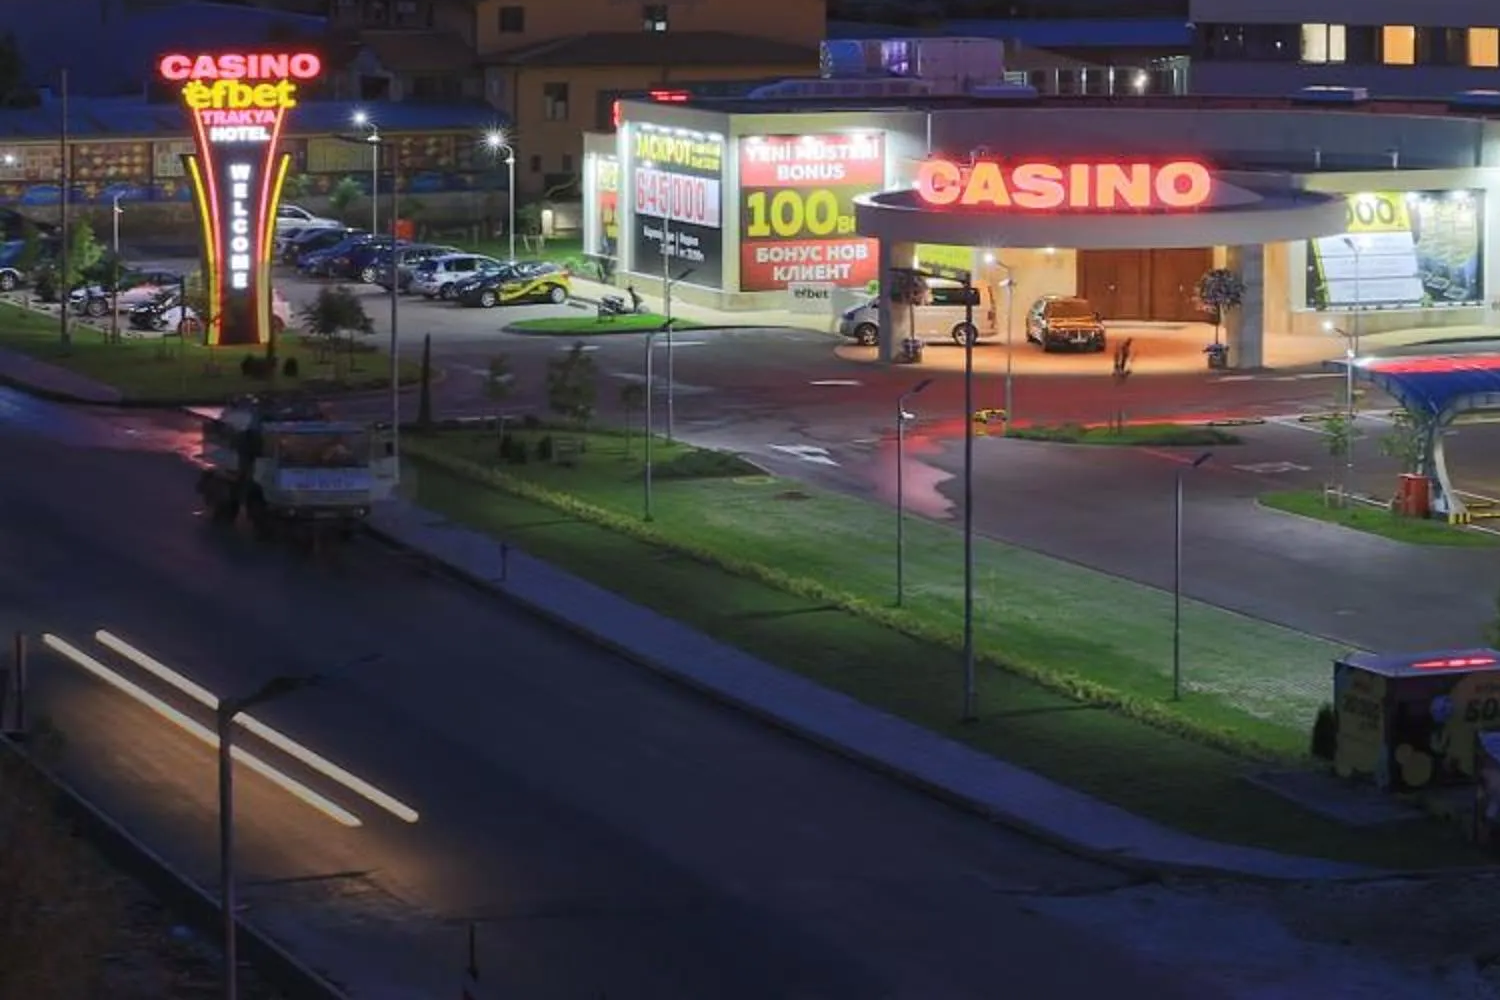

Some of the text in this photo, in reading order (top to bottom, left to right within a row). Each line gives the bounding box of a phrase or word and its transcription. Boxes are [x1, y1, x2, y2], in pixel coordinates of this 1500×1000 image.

[160, 54, 320, 80] CASINO
[184, 80, 297, 108] efbet
[202, 110, 276, 124] TRAKYA
[210, 126, 270, 141] HOTEL
[777, 164, 846, 181] BONUS
[918, 159, 1211, 209] CASINO
[747, 190, 838, 238] 100
[756, 243, 869, 263] БОНУС НОВ
[773, 263, 851, 281] КЛИЕНТ
